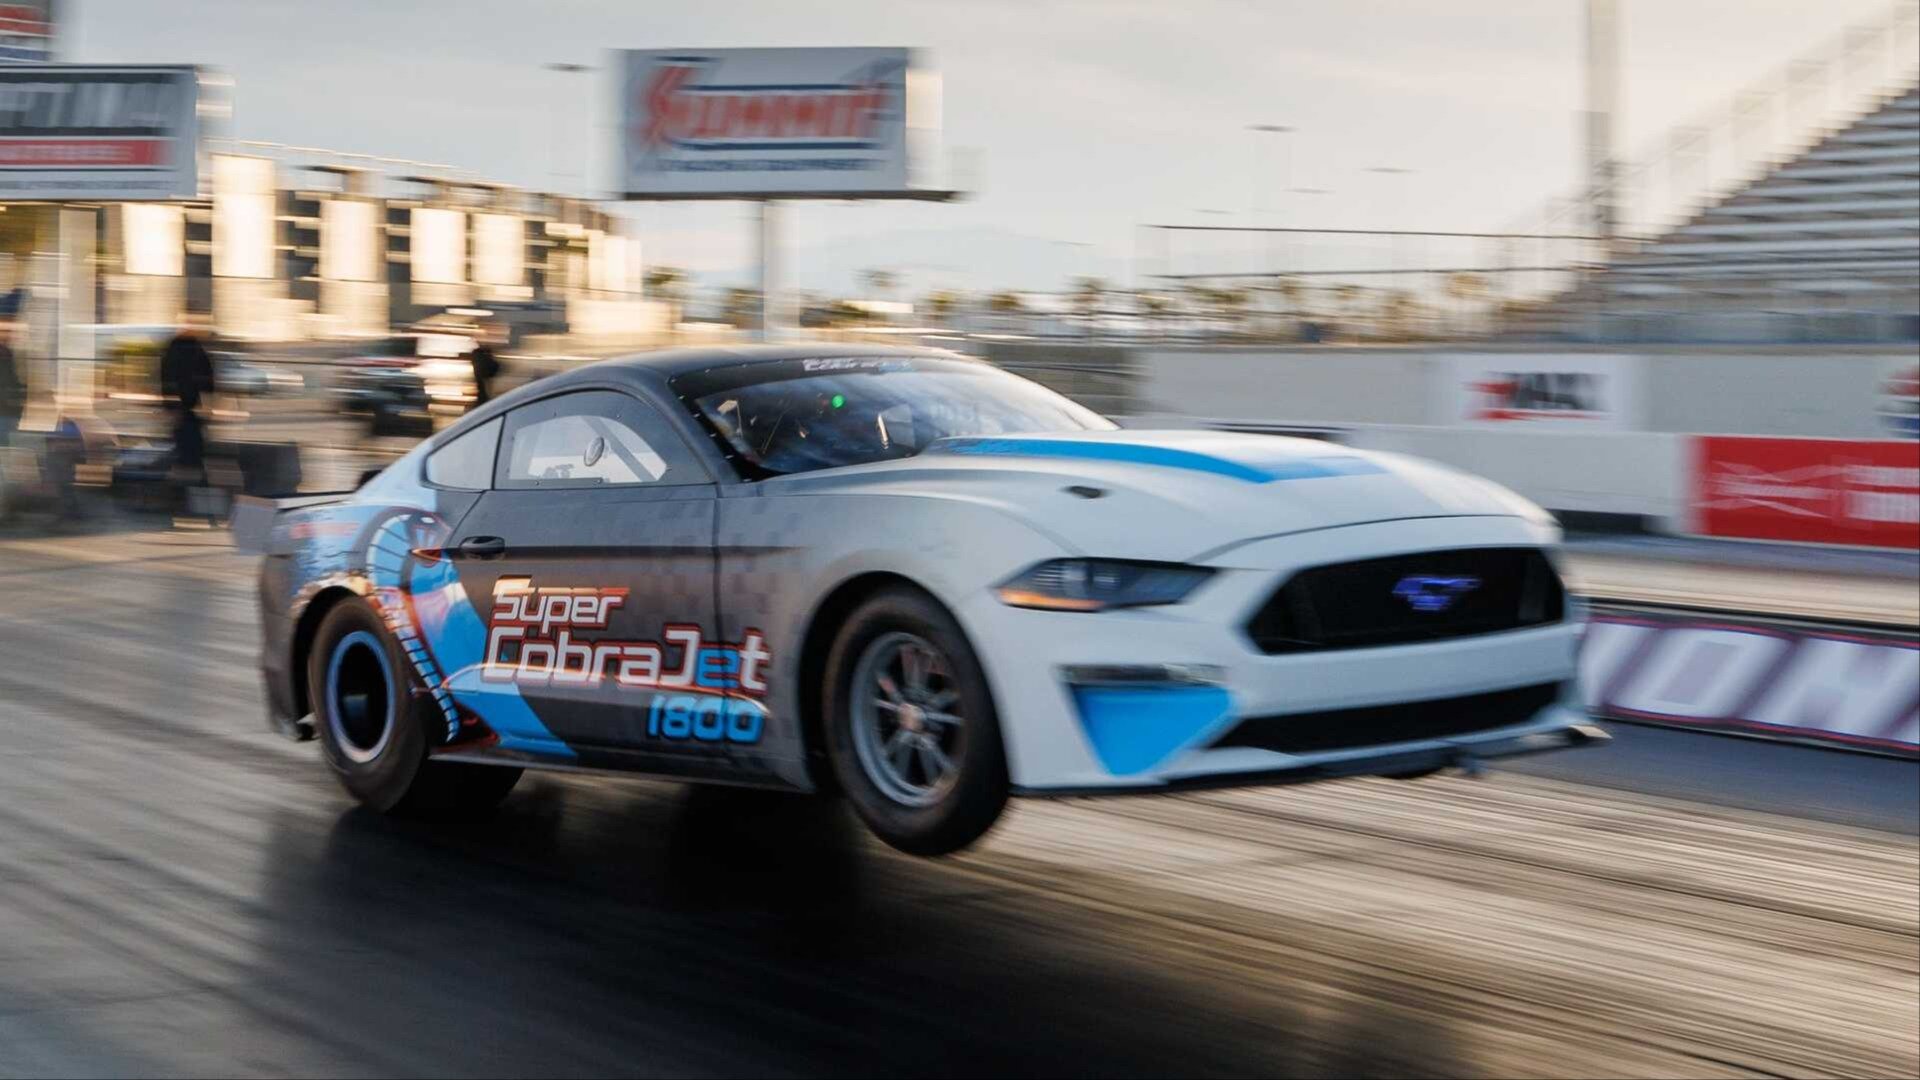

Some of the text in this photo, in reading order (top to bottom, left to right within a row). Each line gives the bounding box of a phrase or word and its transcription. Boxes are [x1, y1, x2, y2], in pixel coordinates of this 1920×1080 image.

[492, 576, 630, 634] Super
[482, 625, 770, 692] CobraJet
[648, 695, 764, 741] 1800
